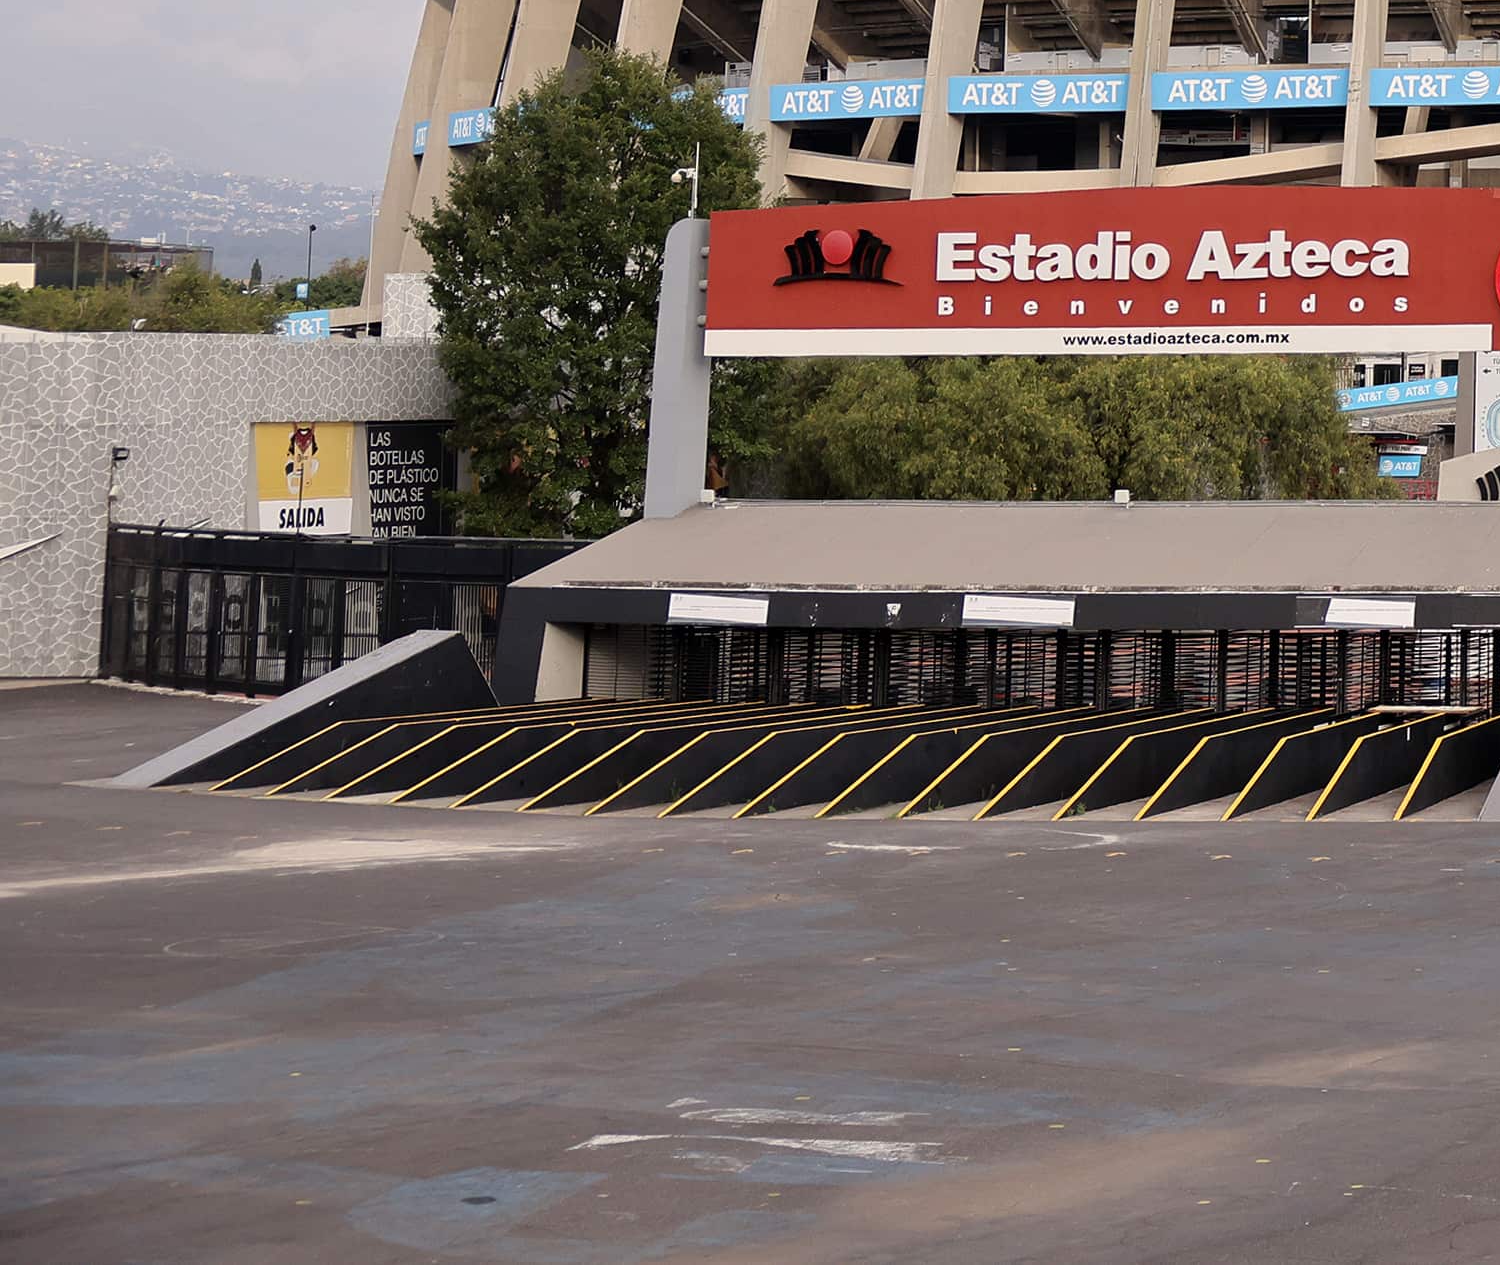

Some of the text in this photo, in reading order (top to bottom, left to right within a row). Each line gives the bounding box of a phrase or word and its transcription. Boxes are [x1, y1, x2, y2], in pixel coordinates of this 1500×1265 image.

[962, 80, 1121, 108] AT&T AT&T
[1168, 77, 1337, 103] AT&T AT&T
[1386, 74, 1453, 99] AT&T
[781, 85, 922, 114] AT&T AT&T
[453, 114, 473, 137] AT&T
[936, 229, 1411, 282] Estadio Azteca
[937, 293, 1409, 316] Bienvenidos
[1063, 331, 1290, 347] www.estadioazteca.com.mx
[1358, 385, 1431, 403] AT&T AT&T
[370, 432, 391, 447] LAS
[369, 450, 425, 466] BOTELLAS
[1395, 462, 1417, 471] AT&T
[369, 466, 439, 485] DE PLÁSTICO
[369, 487, 425, 504] NUNCA SE
[279, 507, 324, 529] SALIDA
[394, 506, 425, 522] VISTO
